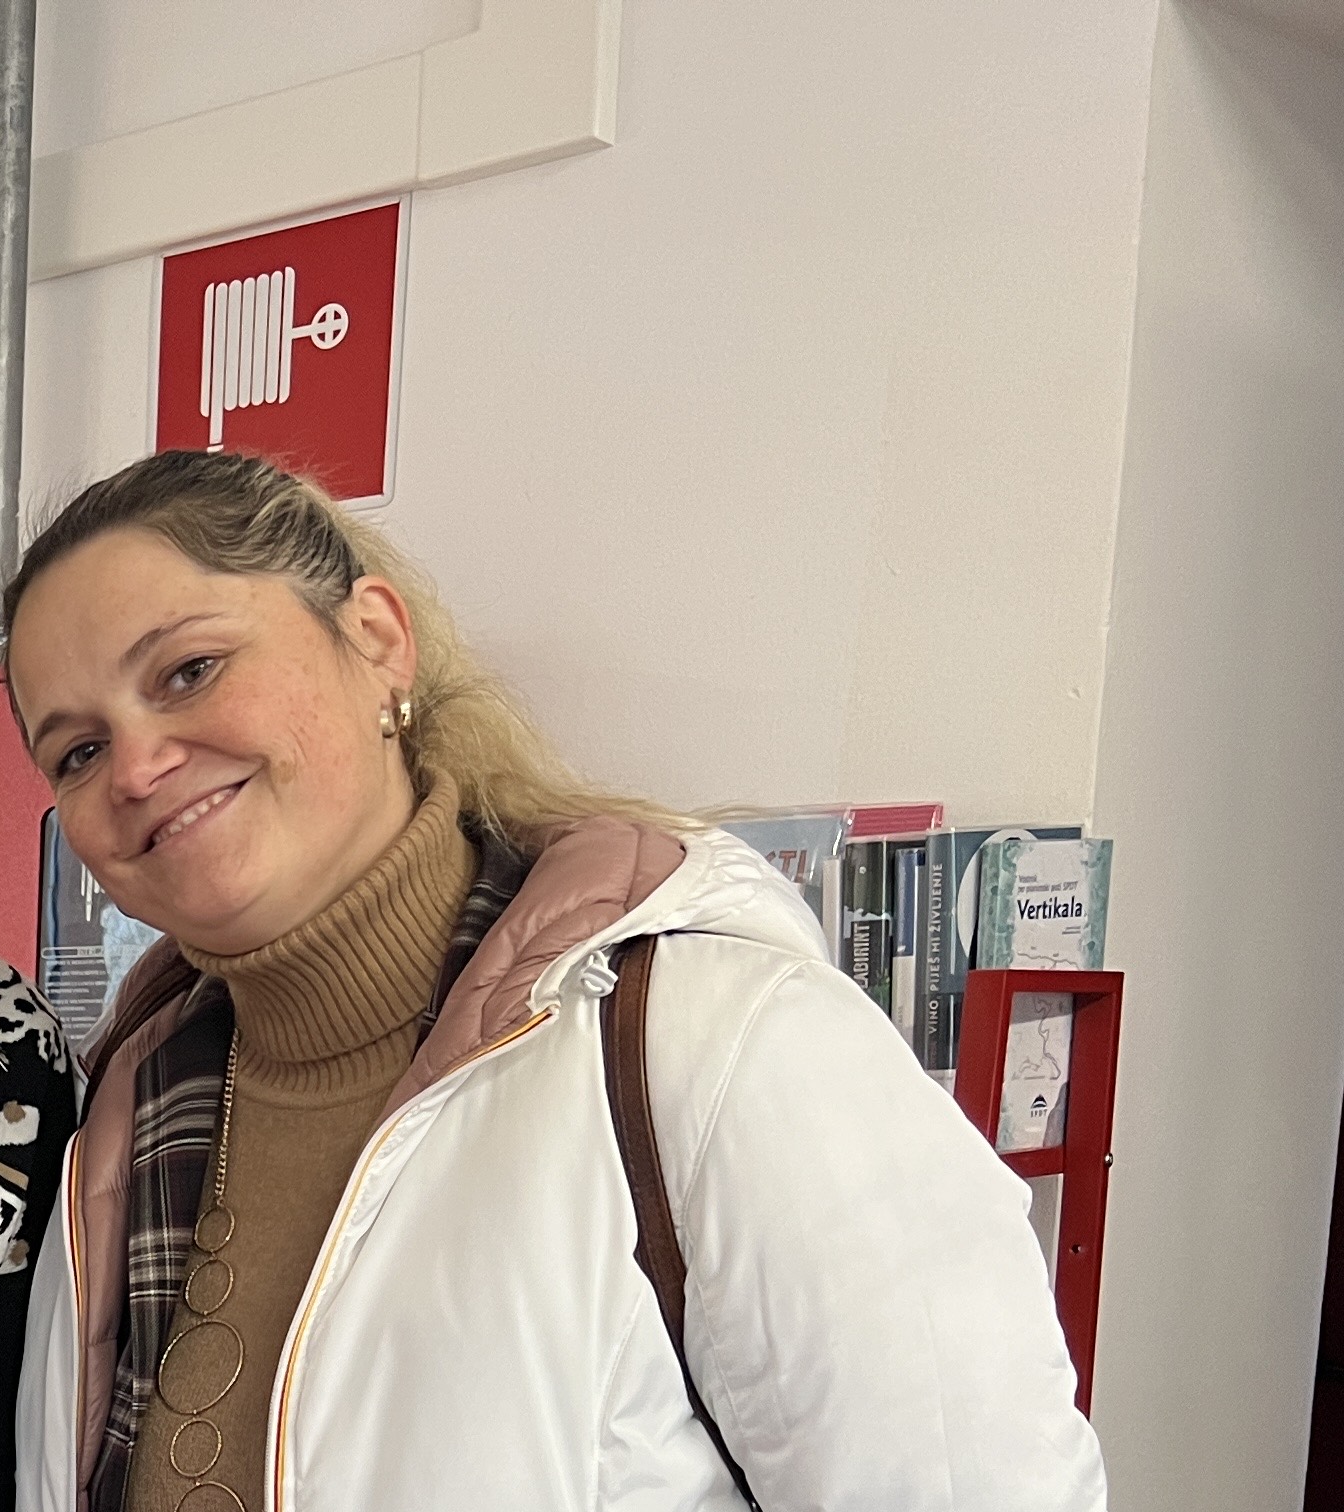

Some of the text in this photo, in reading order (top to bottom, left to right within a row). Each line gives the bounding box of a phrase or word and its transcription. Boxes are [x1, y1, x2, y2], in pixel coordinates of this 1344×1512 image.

[929, 863, 944, 933] ŽIVLJENJE
[1017, 895, 1083, 920] Vertikala
[852, 923, 871, 989] LABIRINT
